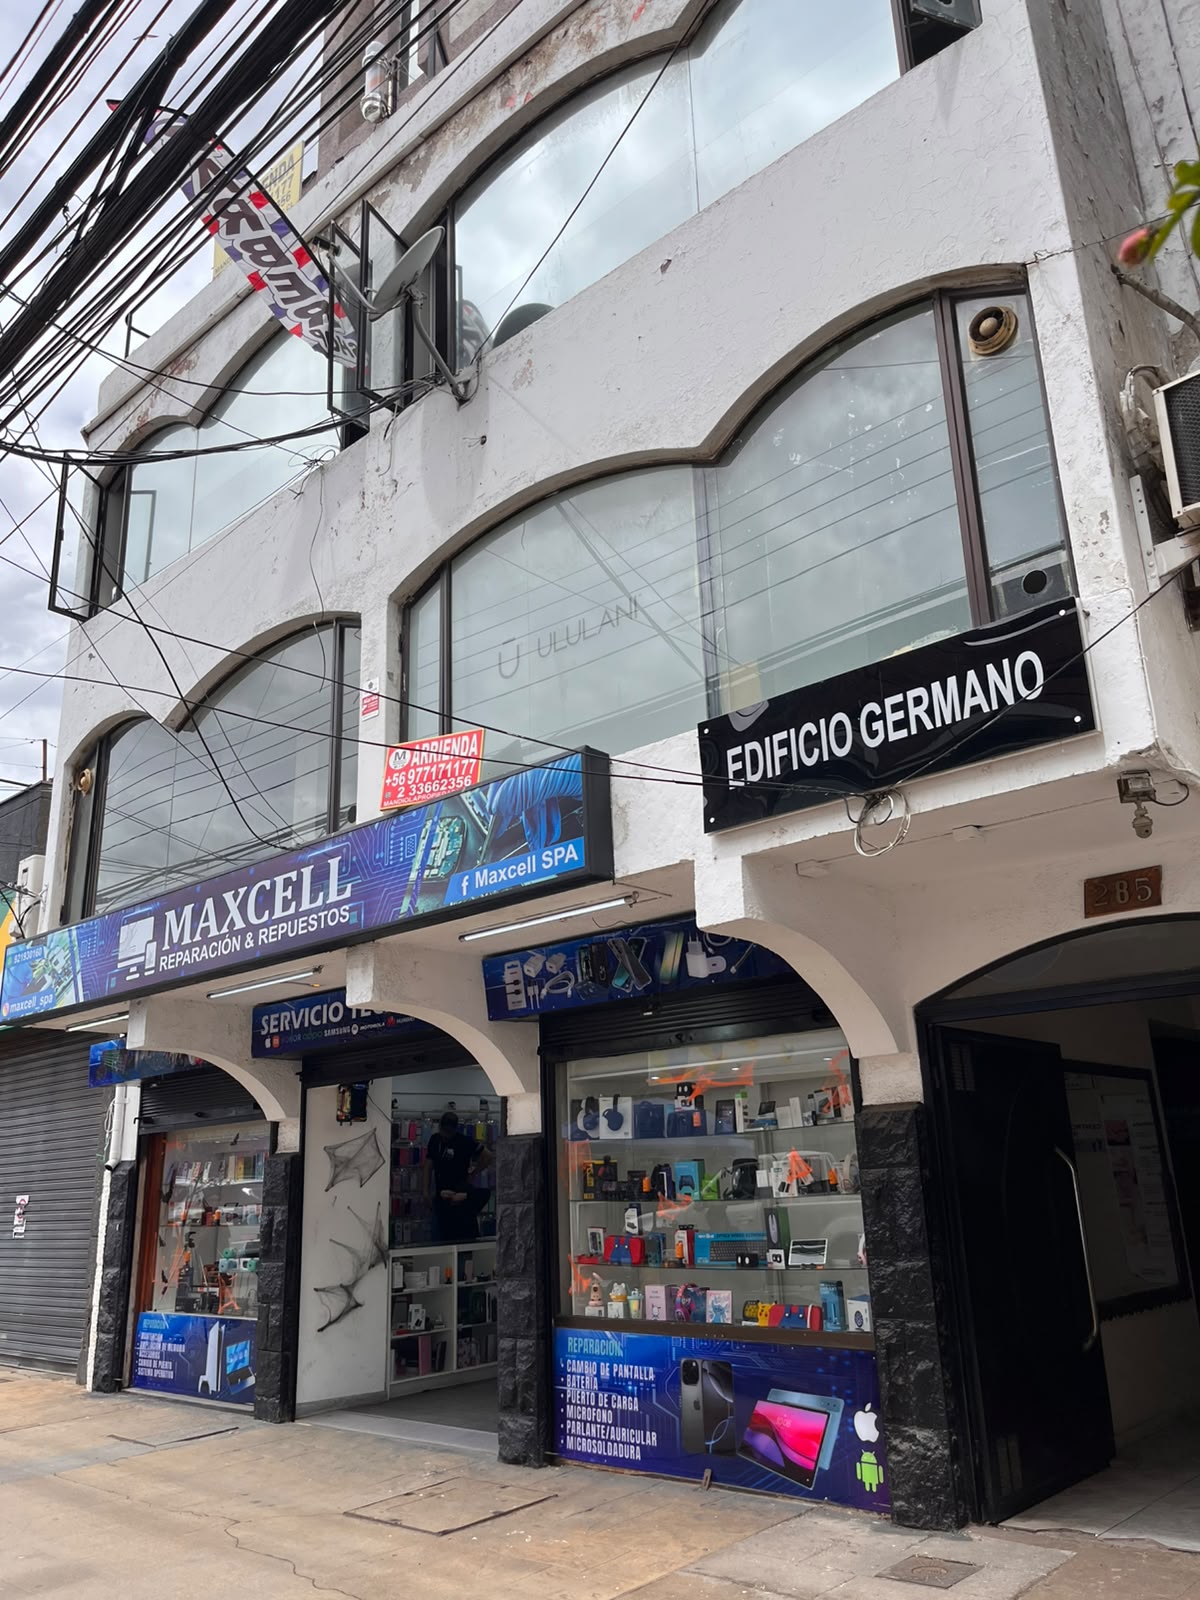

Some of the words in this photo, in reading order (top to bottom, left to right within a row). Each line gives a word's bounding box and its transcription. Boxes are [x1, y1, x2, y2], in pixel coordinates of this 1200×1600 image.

[726, 712, 853, 790] EDIFICIO
[859, 650, 1045, 749] GERMANO
[410, 733, 478, 767] ARRIENDA
[385, 771, 406, 788] +56
[397, 786, 405, 798] 2
[408, 775, 472, 796] 33662356
[475, 854, 536, 888] Maxcell
[541, 843, 578, 869] SPA
[162, 856, 351, 951] MAXCELL
[1094, 877, 1152, 907] 285
[159, 934, 241, 971] REPARACIÓN
[244, 932, 254, 949] &
[258, 905, 350, 945] REPUESTOS
[261, 1001, 344, 1036] SERVICIO
[324, 1026, 351, 1037] SAMSUNG
[566, 1359, 598, 1376] CAMBIO
[600, 1362, 610, 1377] DE
[613, 1363, 655, 1381] PANTALLA
[566, 1389, 596, 1406] PUERTO
[598, 1394, 609, 1408] DE
[611, 1394, 639, 1411] CARGA
[566, 1404, 613, 1424] MICROFONO
[566, 1420, 658, 1447] PARLANTE/AURICULAR
[566, 1435, 642, 1461] MICROSOLDADURA
